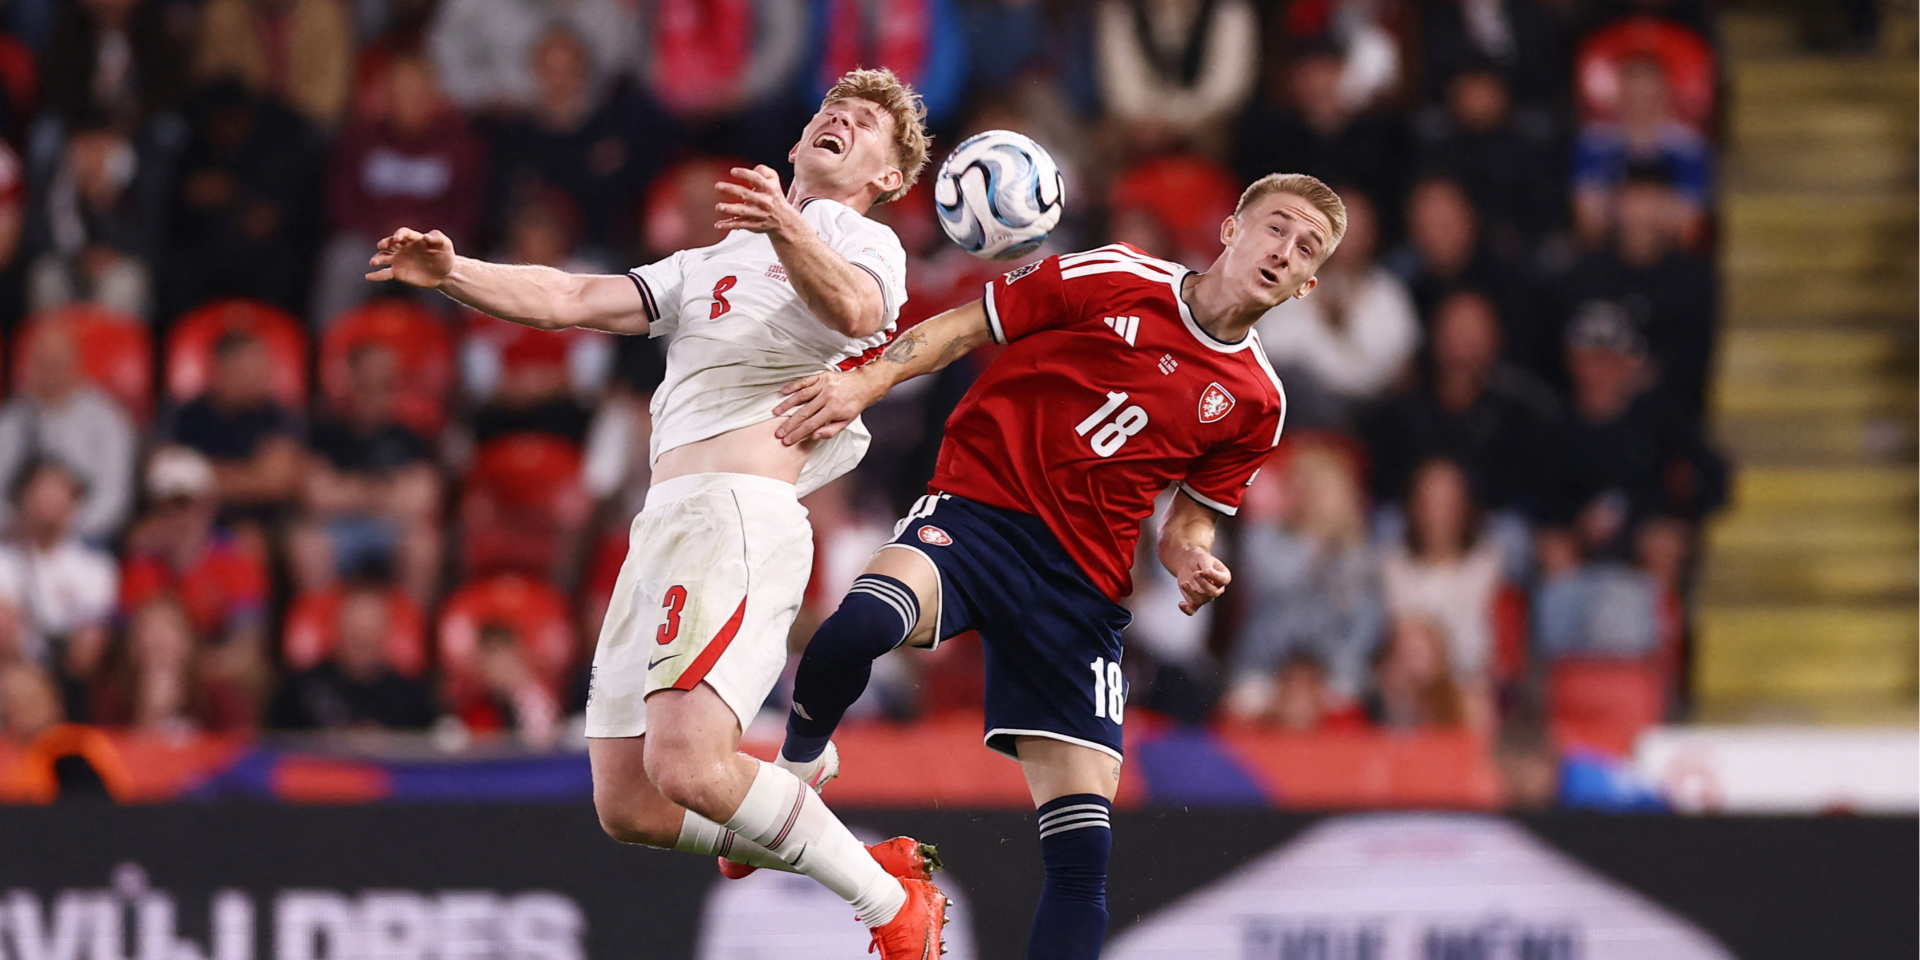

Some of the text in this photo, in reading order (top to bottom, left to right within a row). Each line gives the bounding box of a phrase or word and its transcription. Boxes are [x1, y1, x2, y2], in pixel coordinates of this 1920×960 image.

[1075, 390, 1149, 458] 18
[656, 584, 688, 646] 3
[1090, 656, 1125, 726] 18
[0, 862, 256, 960] VŮJ
